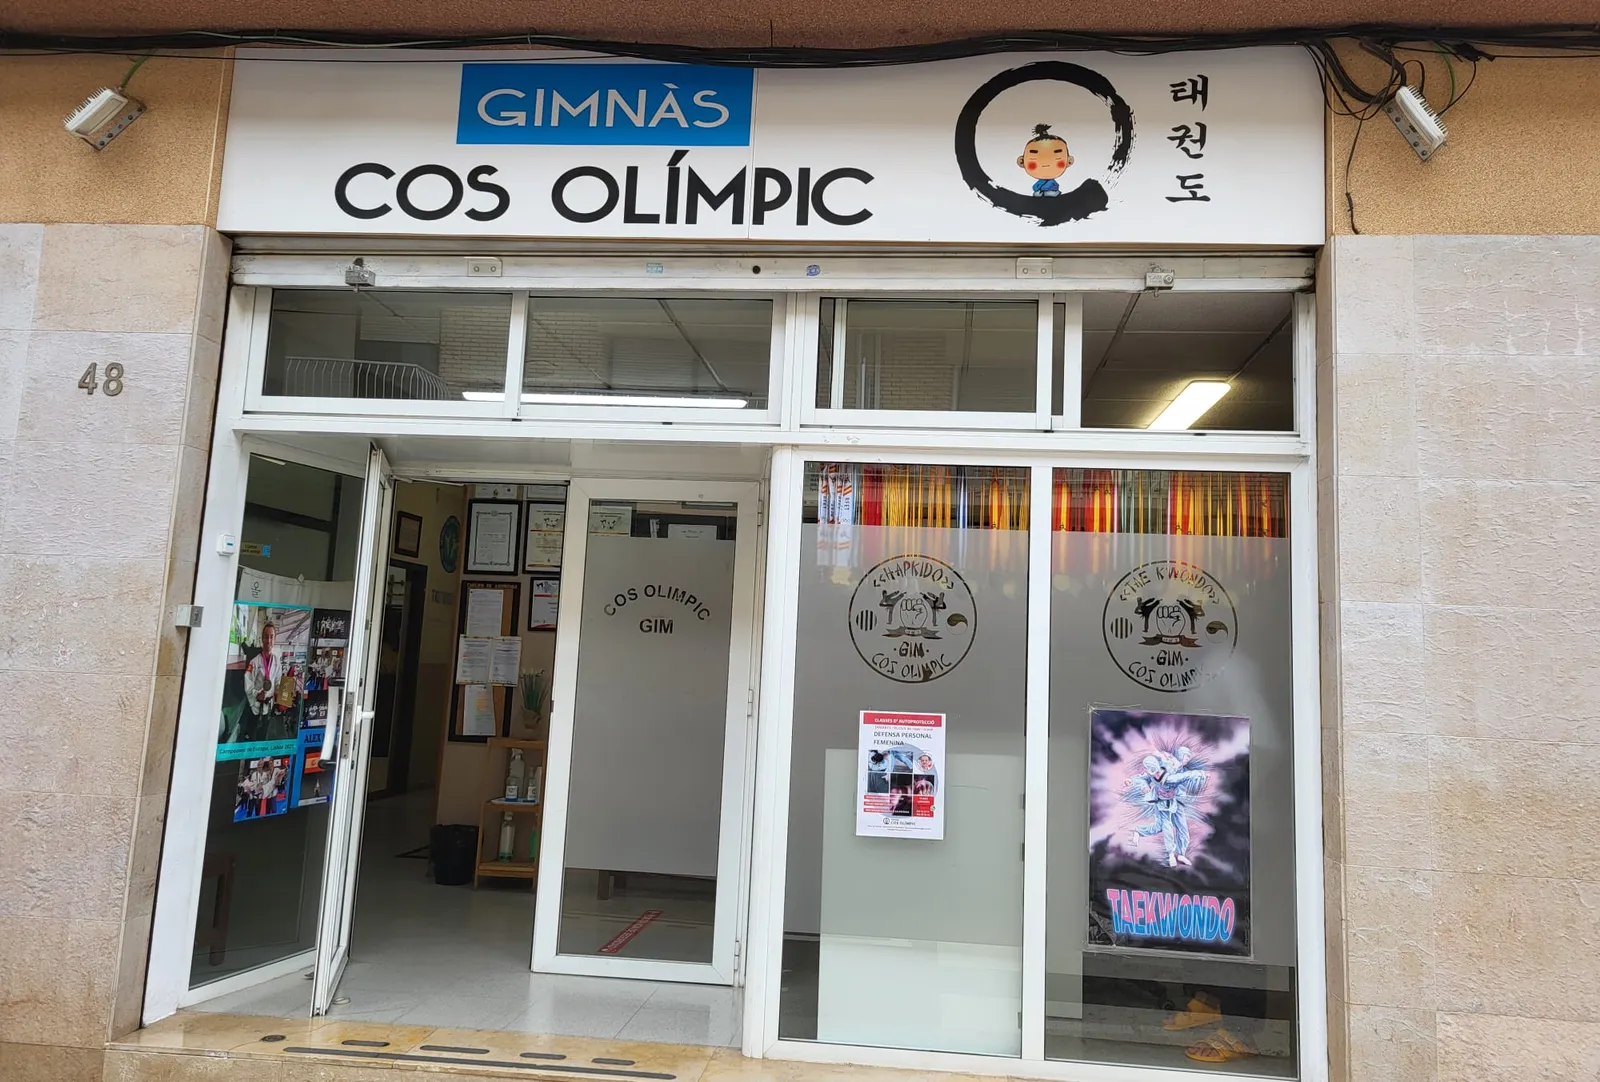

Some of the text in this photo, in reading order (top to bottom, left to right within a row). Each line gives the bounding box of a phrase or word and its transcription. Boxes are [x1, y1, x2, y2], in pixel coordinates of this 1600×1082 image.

[477, 83, 730, 129] GIMNÀS
[334, 149, 875, 226] COS OLÍMPIC
[78, 362, 125, 397] 48
[604, 584, 710, 620] COS OLIMPIC
[639, 618, 674, 634] GIM
[872, 653, 952, 680] COS OLIMPIC
[1128, 661, 1156, 683] COS
[304, 733, 321, 743] ALEX
[901, 732, 932, 740] PERSONAL
[1106, 889, 1235, 942] TAEKWONDO
